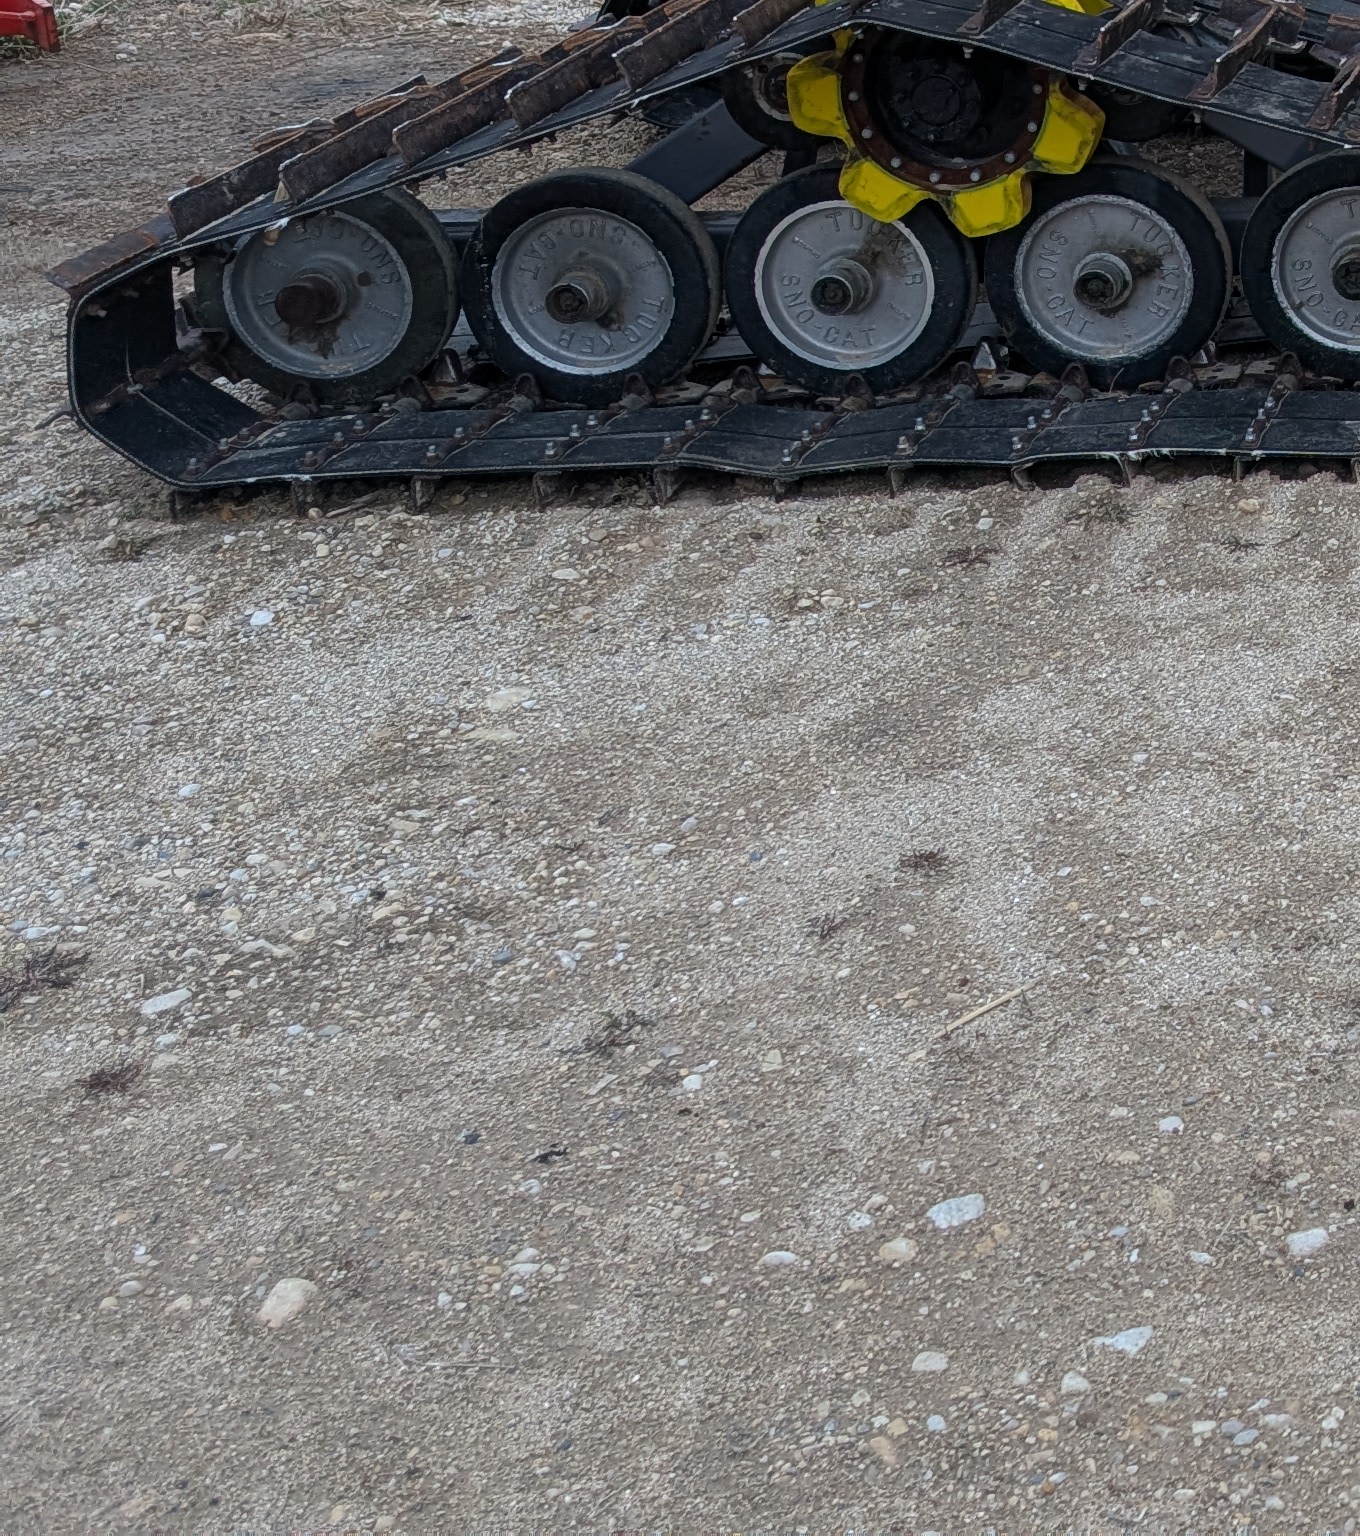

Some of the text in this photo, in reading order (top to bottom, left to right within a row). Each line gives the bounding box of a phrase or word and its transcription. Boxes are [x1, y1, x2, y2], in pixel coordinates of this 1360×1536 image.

[1129, 210, 1181, 318] TUCKER
[558, 296, 668, 354] TUCKER
[778, 272, 876, 347] SNO-CAT
